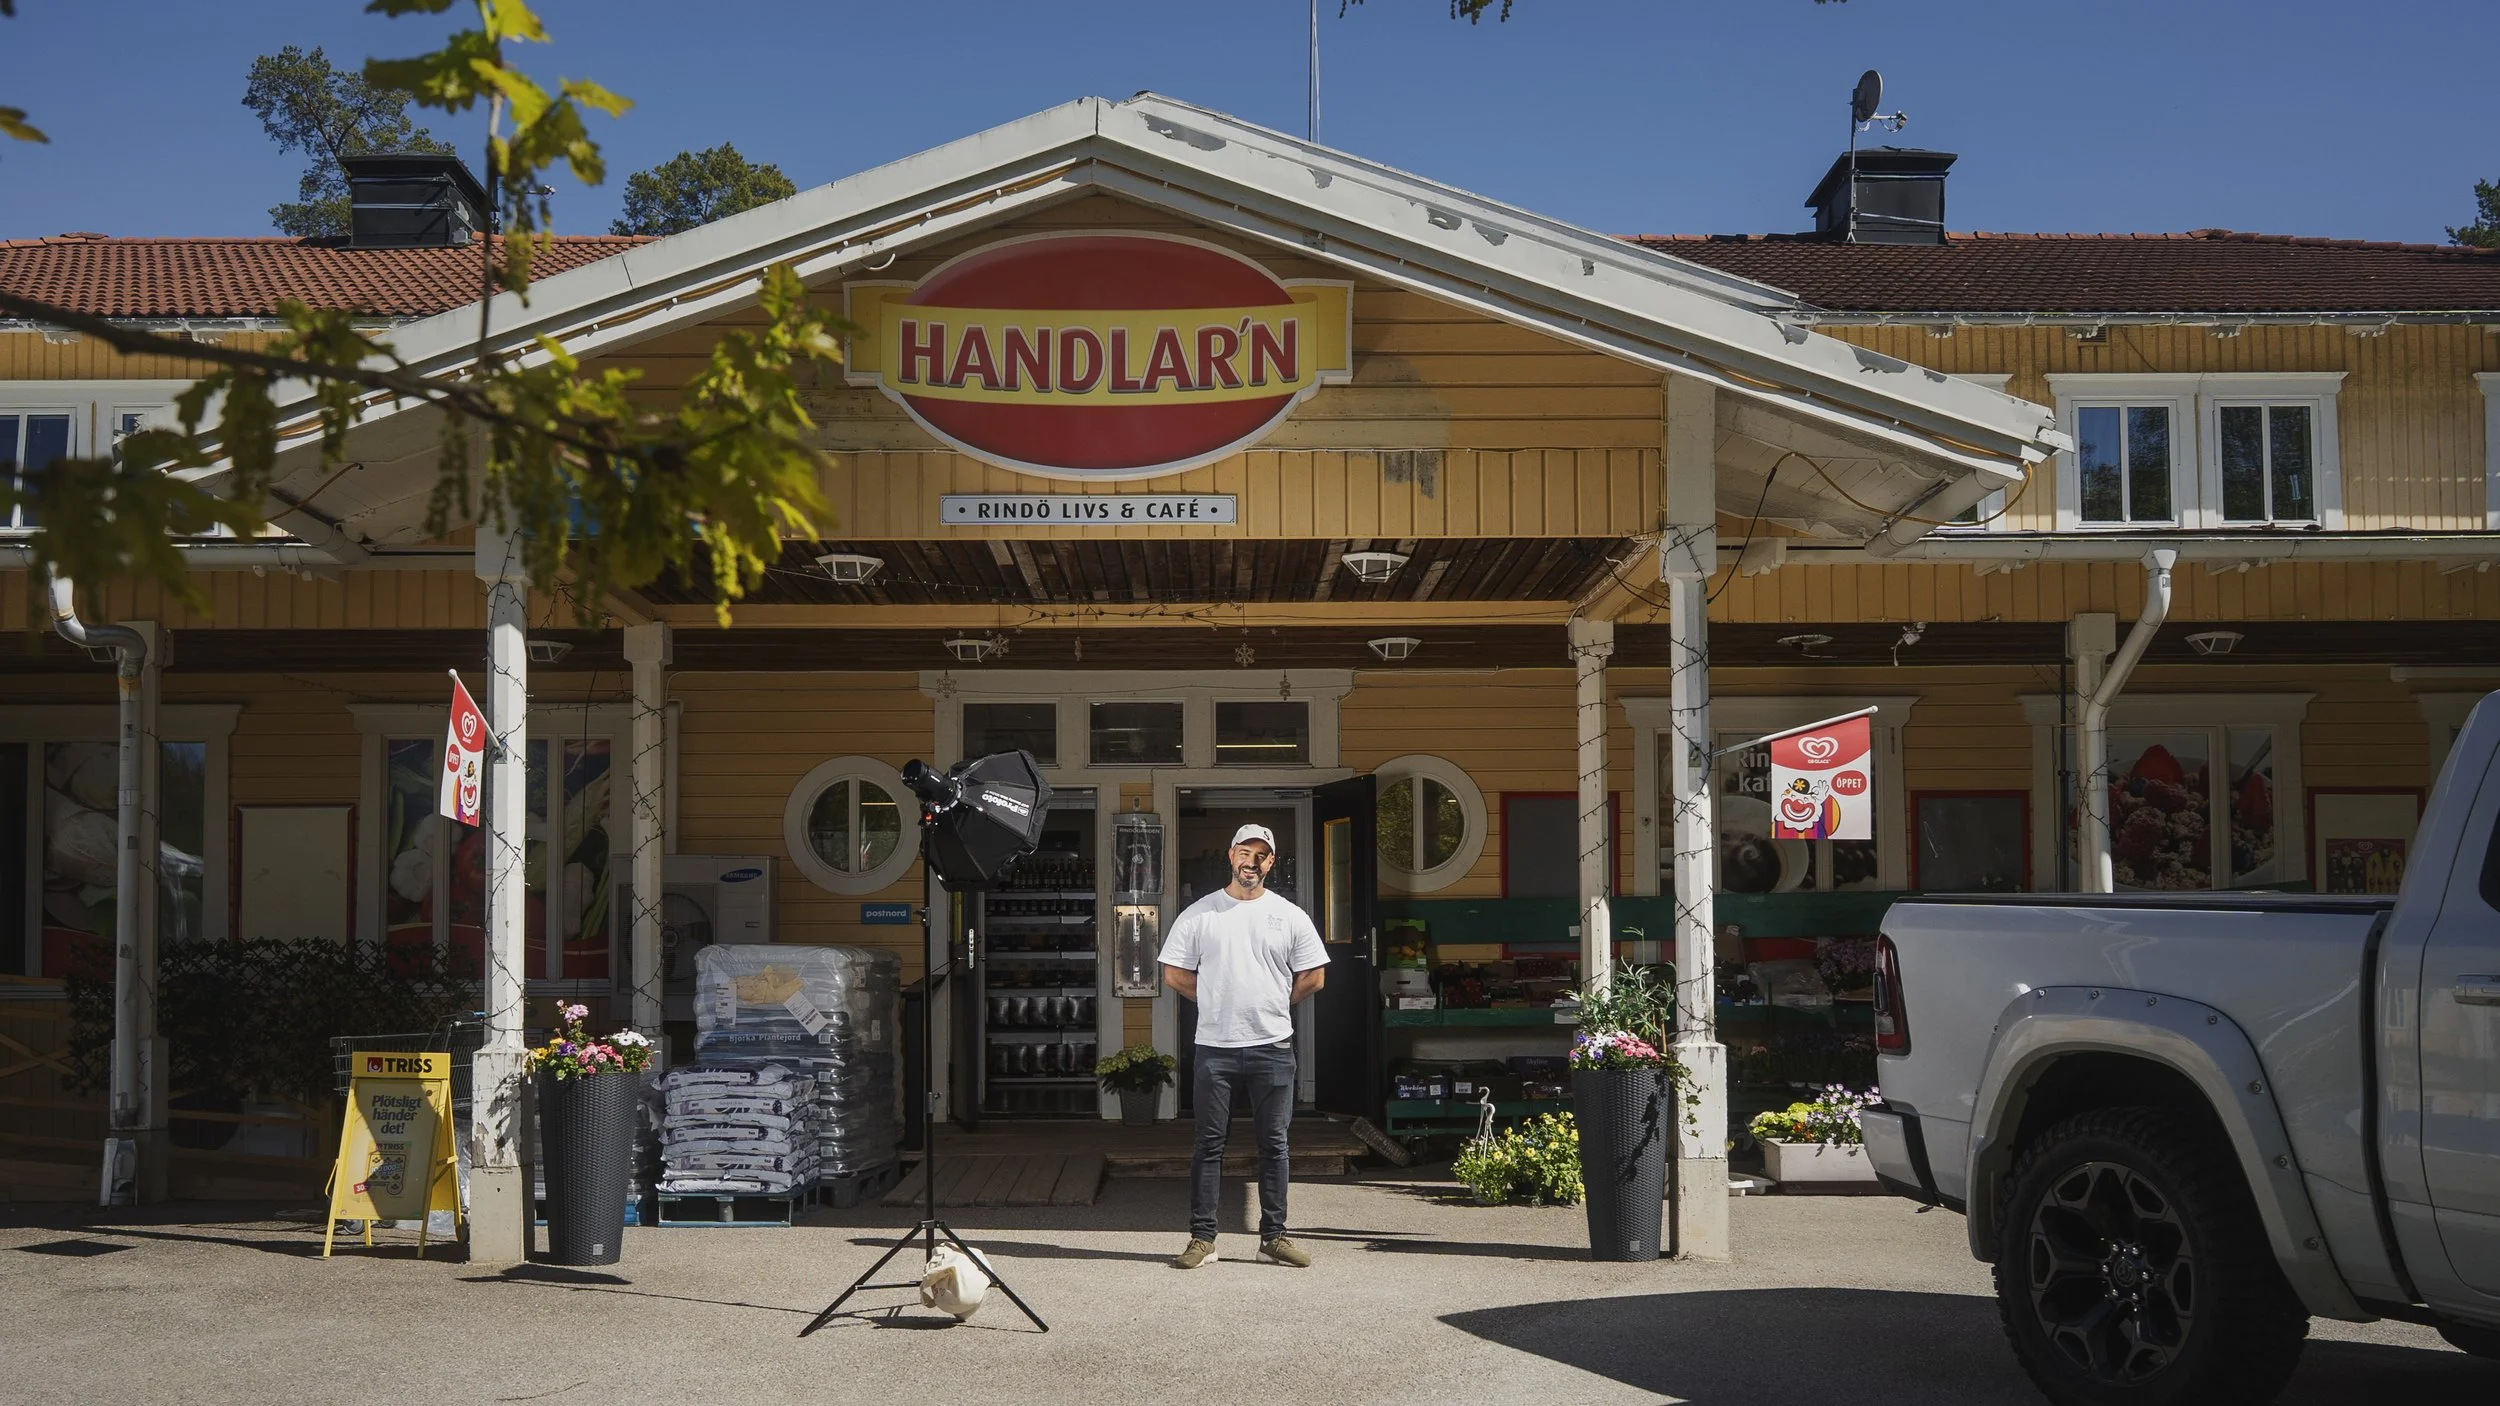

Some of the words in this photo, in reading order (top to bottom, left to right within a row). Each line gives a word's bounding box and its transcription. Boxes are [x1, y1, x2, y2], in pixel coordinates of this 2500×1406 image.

[899, 315, 1300, 393] HANDLAR'N
[977, 498, 1050, 519] RINDÖ
[1062, 503, 1110, 519] LIVS
[1120, 503, 1135, 519] &
[1147, 498, 1199, 519] CAFÉ
[1735, 747, 1770, 768] Rin
[1836, 775, 1862, 789] ÖPPET
[982, 793, 1018, 813] Profoto
[725, 871, 759, 880] SAMSUNG
[865, 908, 907, 919] postnord
[759, 1032, 801, 1043] Plantejord
[384, 1058, 433, 1073] TRISS
[371, 1095, 422, 1111] Plötsligt
[372, 1109, 417, 1121] händer
[380, 1122, 405, 1135] det!
